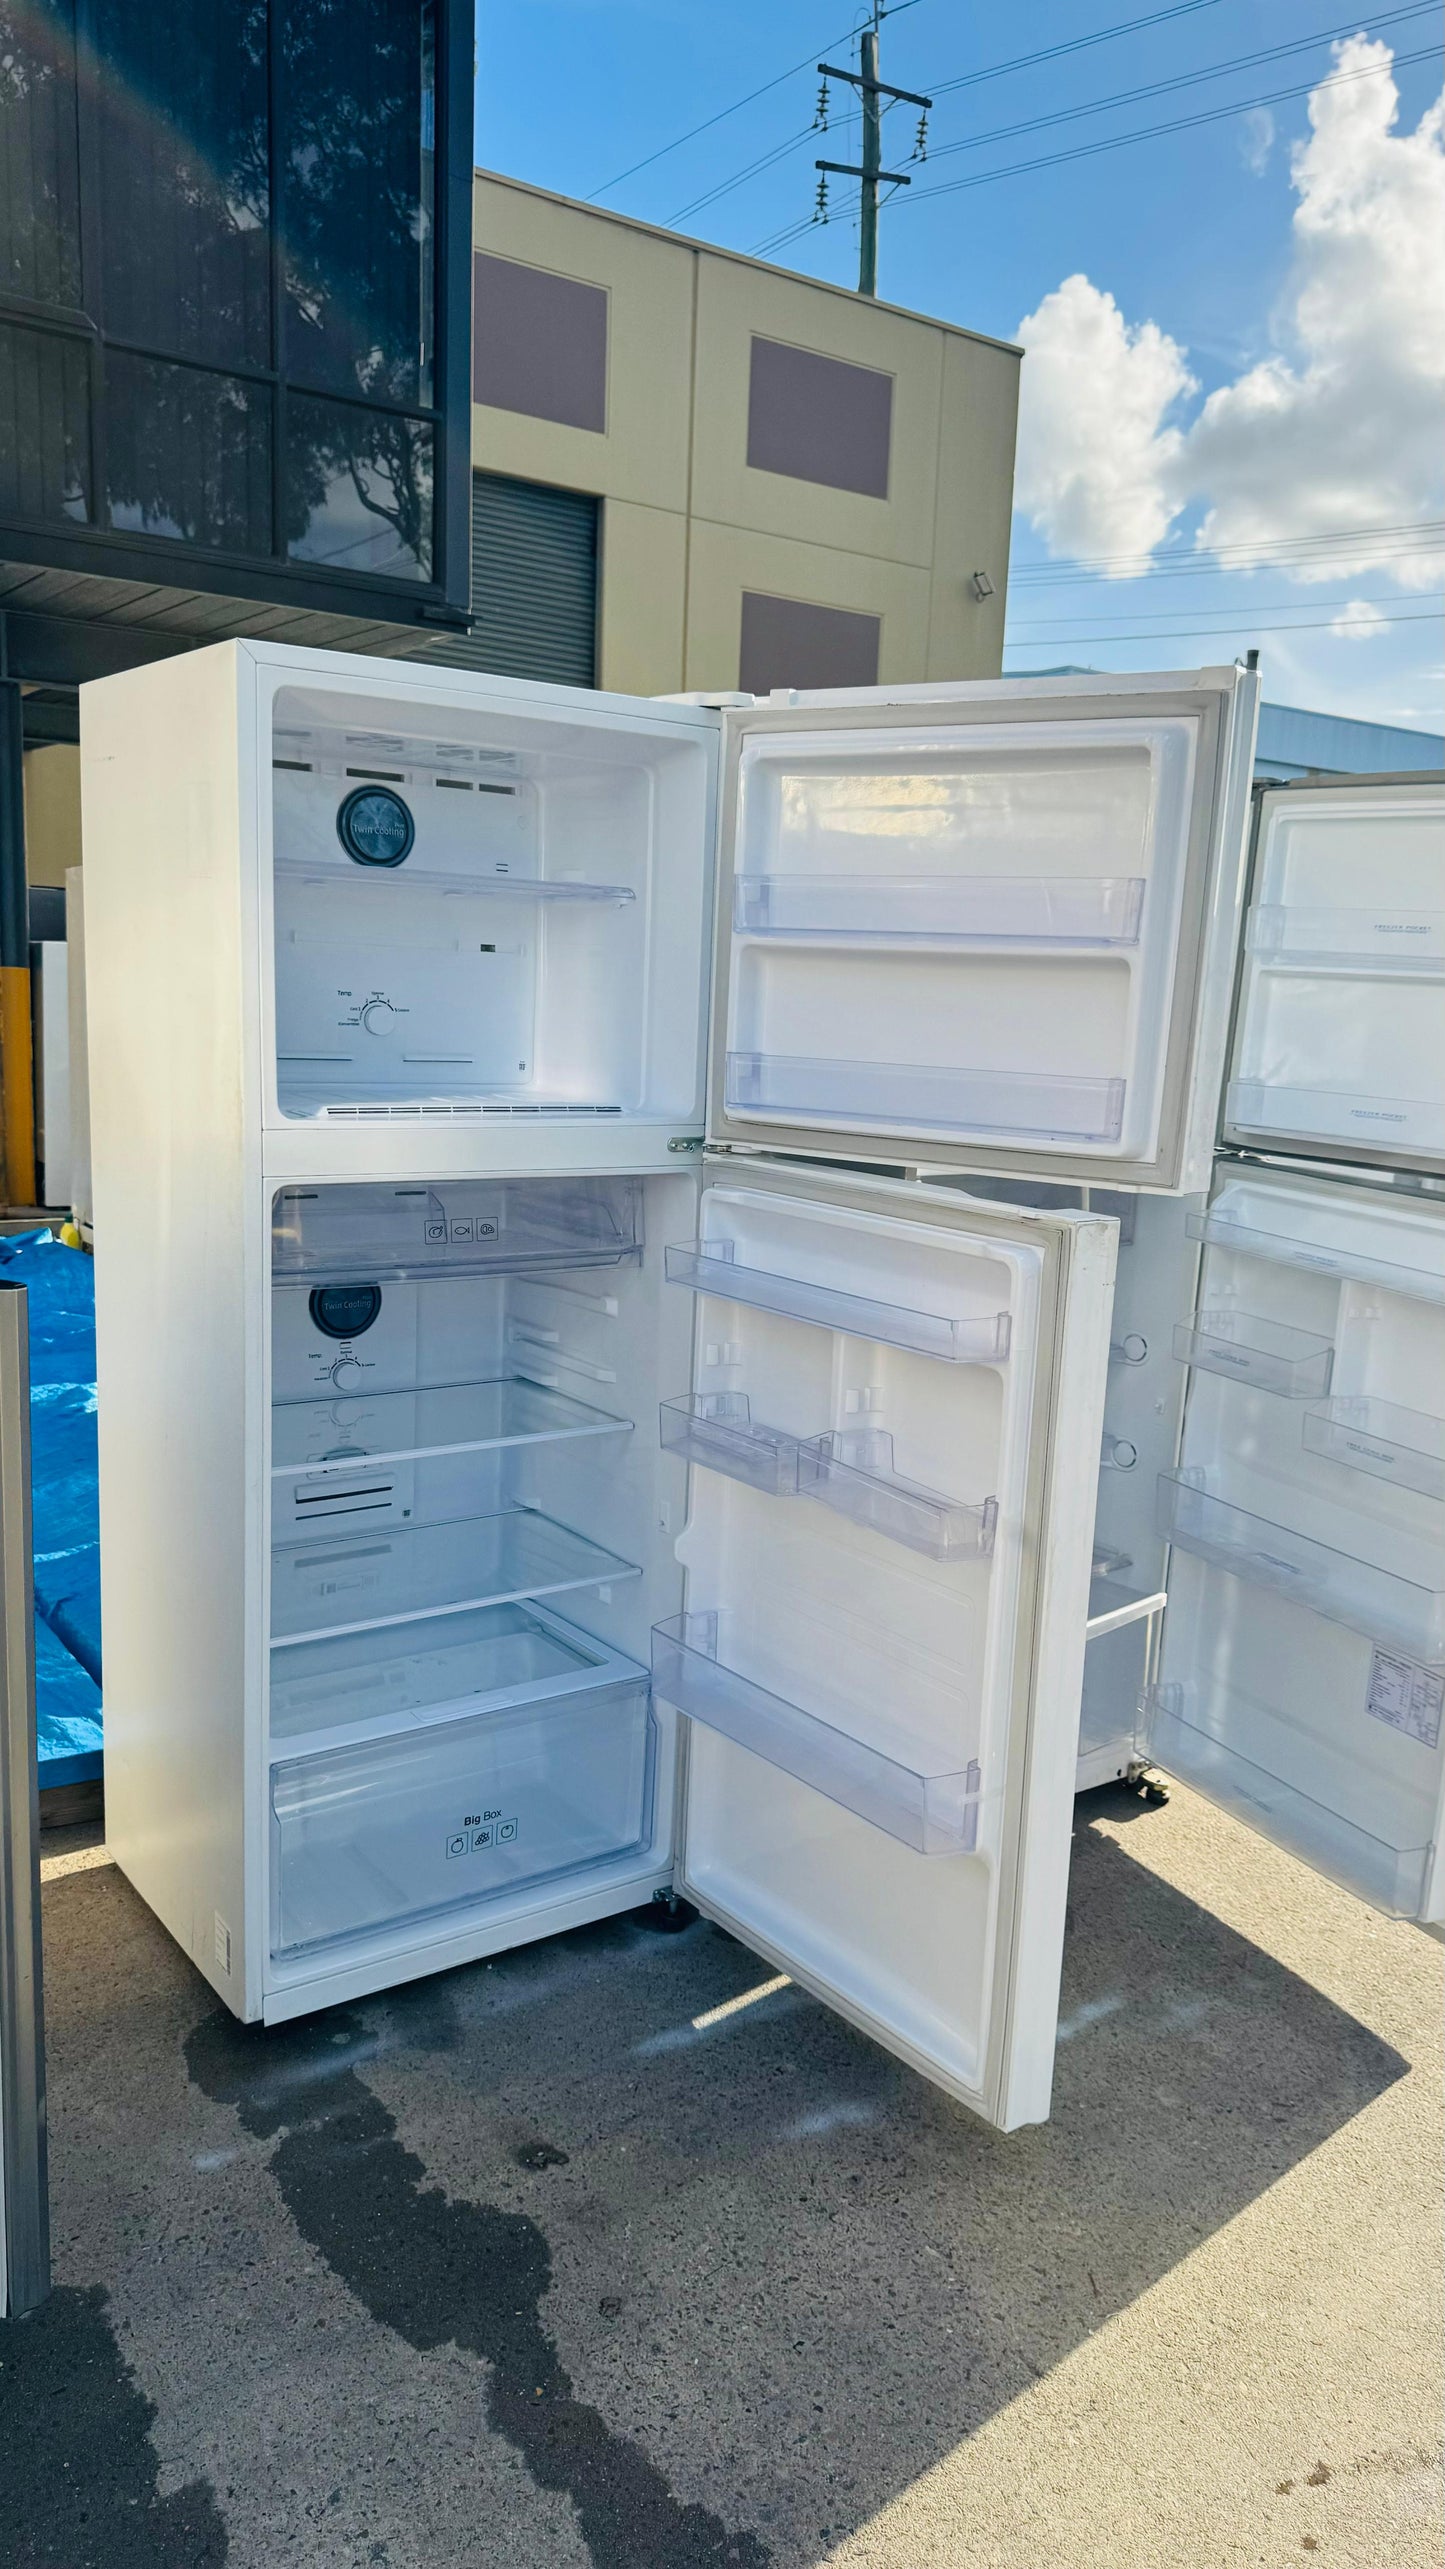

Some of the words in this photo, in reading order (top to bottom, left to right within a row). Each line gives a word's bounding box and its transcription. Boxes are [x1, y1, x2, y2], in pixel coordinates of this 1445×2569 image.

[353, 824, 373, 834] Twin
[374, 825, 405, 839] Cooling
[324, 1302, 342, 1310] Twin
[343, 1299, 371, 1309] Cooling
[464, 1815, 481, 1826] Big
[483, 1809, 502, 1821] Box
